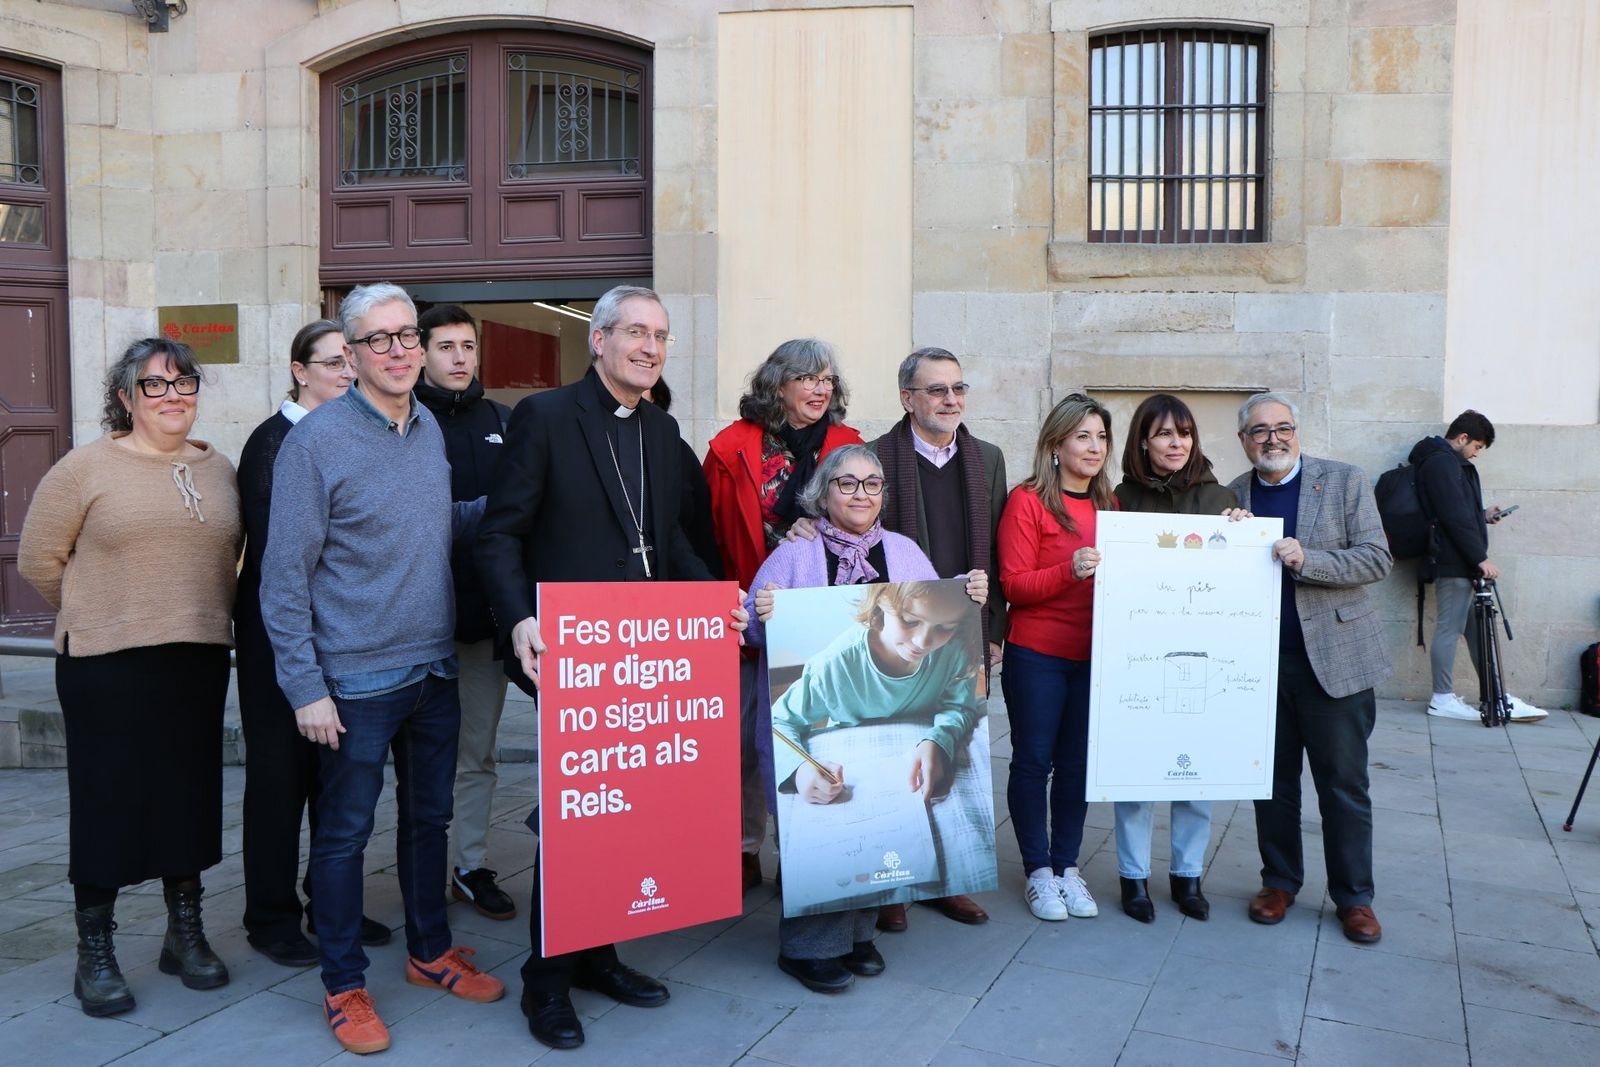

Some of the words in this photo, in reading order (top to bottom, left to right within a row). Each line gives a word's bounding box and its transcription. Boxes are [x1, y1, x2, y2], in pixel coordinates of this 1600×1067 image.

[559, 615, 611, 646] Fes
[617, 618, 670, 648] que
[676, 616, 724, 641] una
[559, 657, 606, 689] llar
[613, 654, 691, 690] digna
[559, 706, 598, 733] no
[605, 695, 669, 732] sigui
[676, 696, 724, 723] una
[560, 742, 647, 776] carta
[655, 733, 698, 766] als
[560, 783, 632, 820] Reis.
